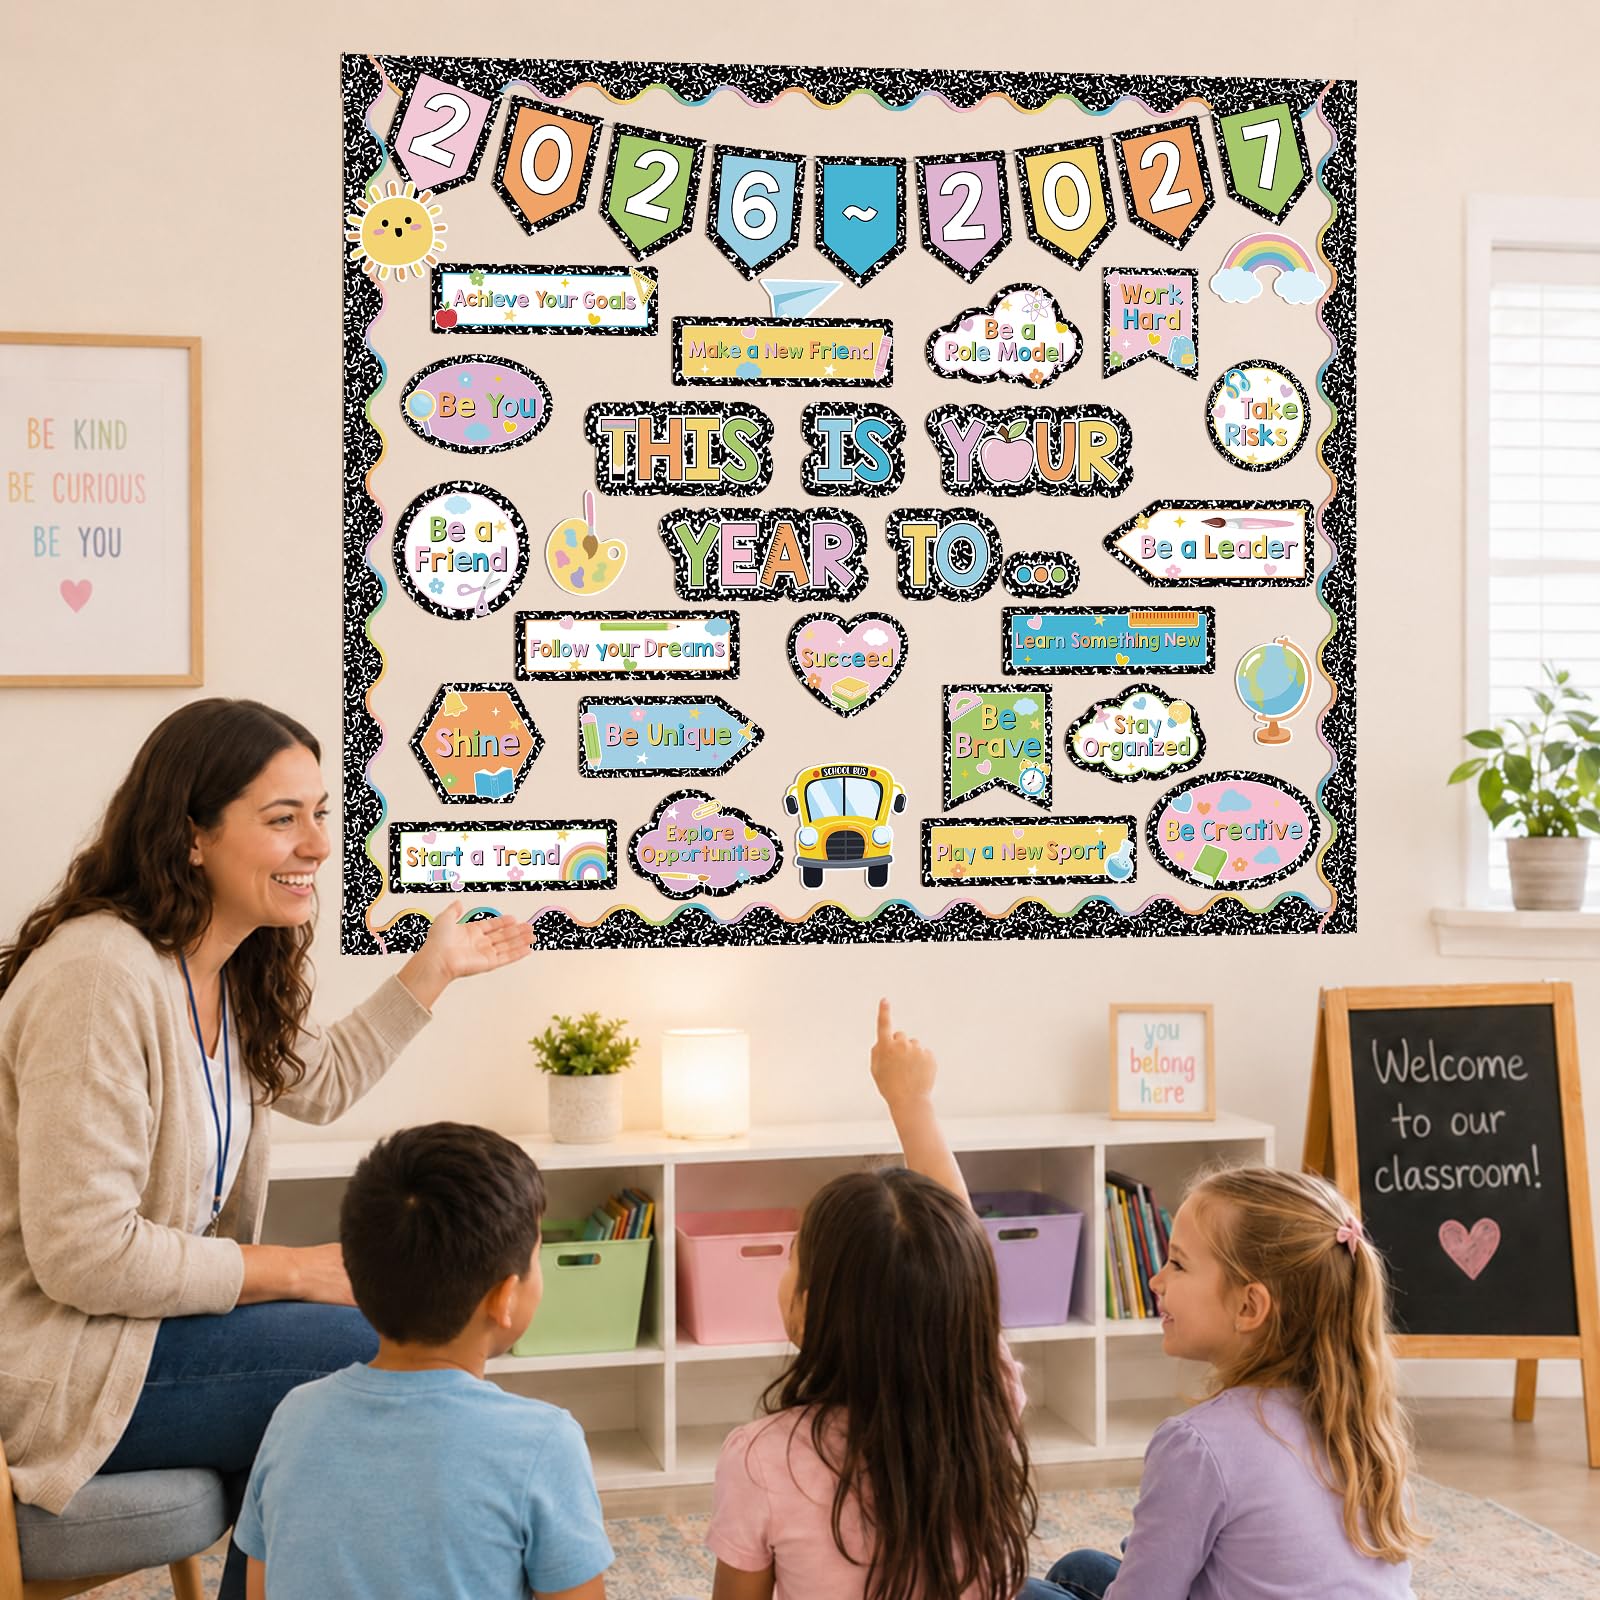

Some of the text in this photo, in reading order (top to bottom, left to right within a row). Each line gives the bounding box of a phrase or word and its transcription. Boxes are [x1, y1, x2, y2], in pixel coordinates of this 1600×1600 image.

[453, 289, 637, 310] Achieve Your Goals
[1120, 283, 1184, 305] Work
[984, 319, 1036, 340] Be a
[1122, 309, 1181, 331] Hard
[689, 341, 873, 361] Make a New Friend
[945, 341, 1064, 363] Role Model
[439, 392, 536, 420] Be You
[1241, 397, 1298, 420] Take
[27, 417, 128, 450] BE KIND
[1225, 424, 1287, 447] Risks
[600, 417, 760, 482] THIS
[817, 416, 894, 483] IS
[8, 471, 146, 504] BE CURIOUS
[34, 526, 121, 558] BE YOU
[430, 517, 493, 543] Be a
[415, 546, 507, 573] Friend
[675, 521, 855, 588] YEAR
[1140, 535, 1298, 560] Be a Leader
[530, 639, 725, 661] Follow your Dreams
[1015, 631, 1201, 652] Learn Something New
[801, 646, 894, 671] Succeed
[981, 704, 1017, 731] Be
[1114, 715, 1162, 739] Stay
[435, 729, 520, 758] Shine
[605, 723, 732, 752] Be Unique
[955, 734, 1042, 759] Brave
[1083, 738, 1191, 760] Organized
[823, 766, 867, 776] SCHOOL BUS
[666, 824, 735, 843] Explore
[1165, 818, 1303, 841] Be Creative
[406, 844, 561, 868] Start a Trend
[641, 843, 771, 865] Opportunities
[937, 840, 1107, 865] Play a New Sport
[1143, 1023, 1180, 1050] you
[1130, 1047, 1196, 1082] belong
[1371, 1037, 1528, 1084] Welcome
[1140, 1080, 1184, 1104] here
[1391, 1102, 1505, 1140] to our
[1374, 1144, 1543, 1193] classroom!
